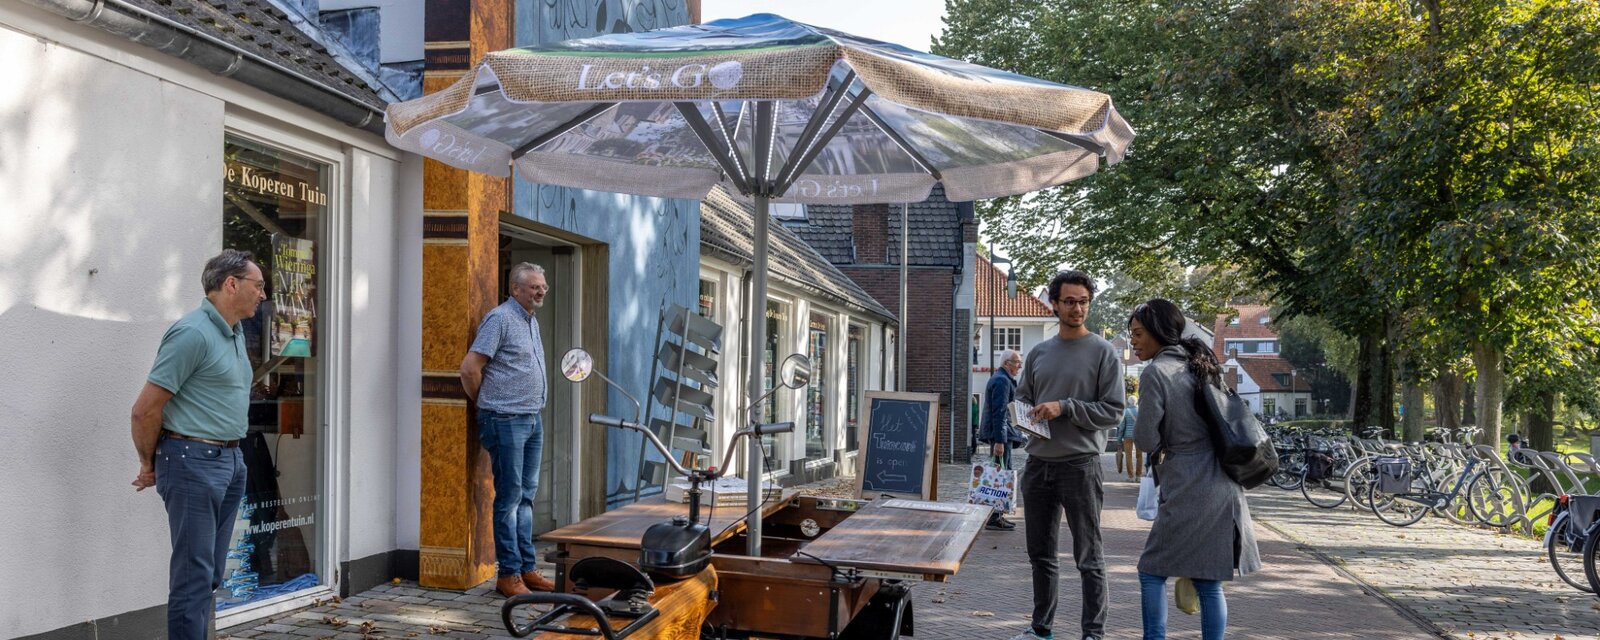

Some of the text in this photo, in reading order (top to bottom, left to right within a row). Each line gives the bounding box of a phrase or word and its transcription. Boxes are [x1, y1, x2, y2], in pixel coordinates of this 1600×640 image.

[576, 64, 661, 91] Let's
[241, 166, 294, 198] Koperen
[299, 181, 327, 206] Tuin
[275, 254, 316, 279] Wieringa
[980, 486, 1008, 498] ACTION
[239, 513, 315, 536] www.koperentuin.nl
